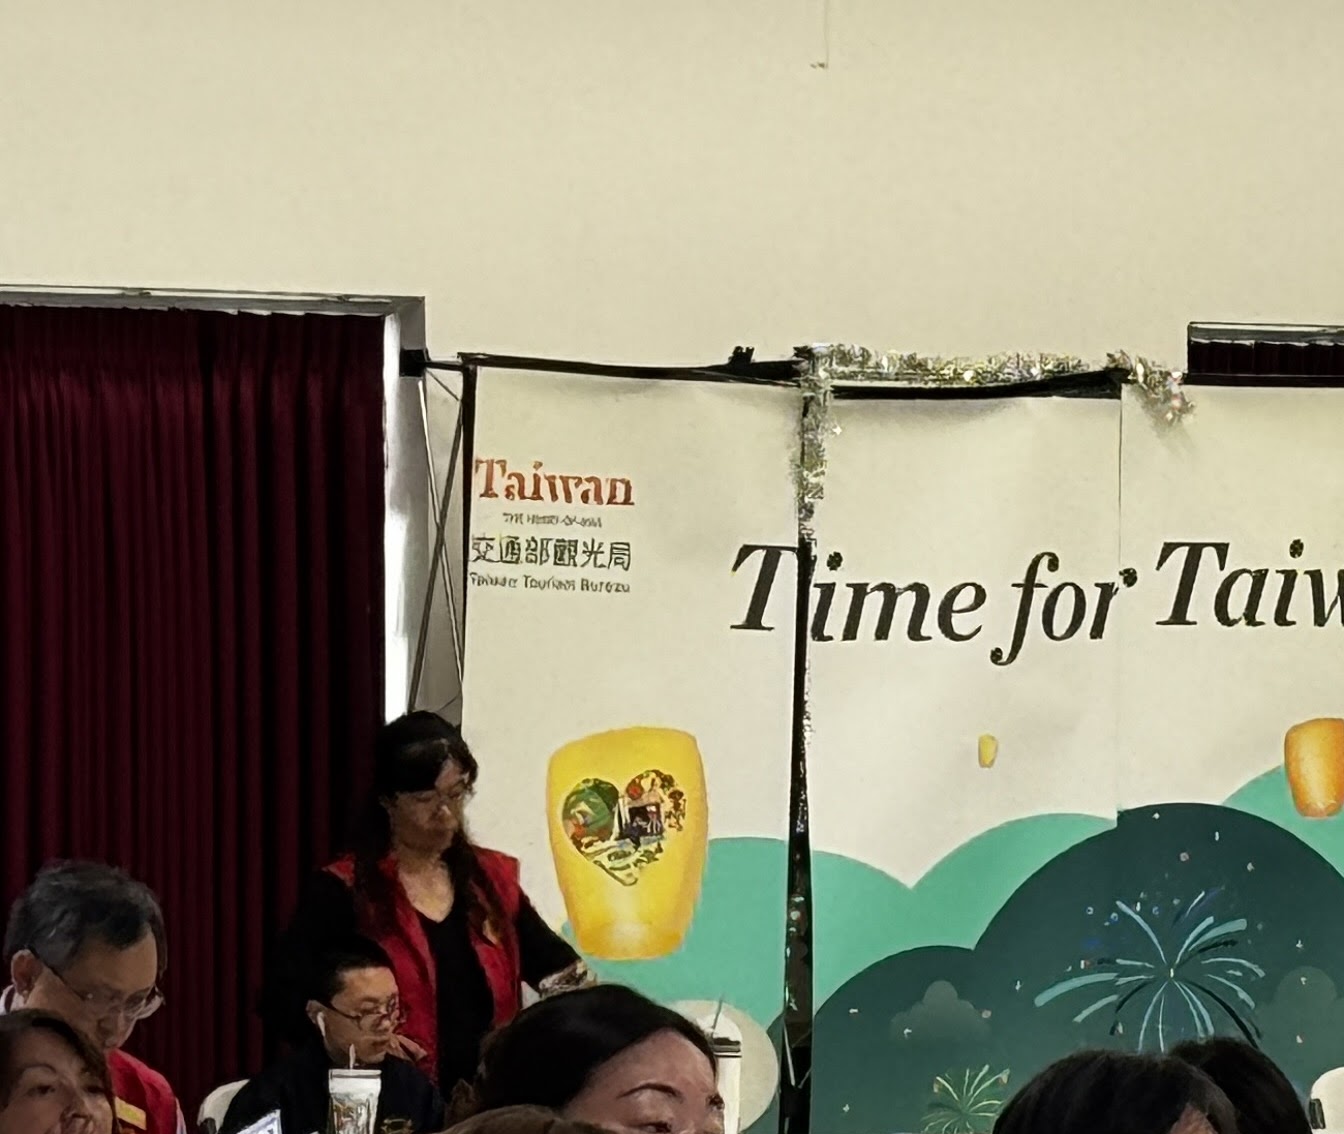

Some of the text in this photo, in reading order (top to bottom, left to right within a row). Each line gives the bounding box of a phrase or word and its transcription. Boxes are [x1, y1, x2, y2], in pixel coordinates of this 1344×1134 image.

[475, 459, 635, 506] Taiwan
[469, 533, 632, 572] 交通部觀光局
[729, 543, 986, 642] Time
[989, 551, 1138, 666] for
